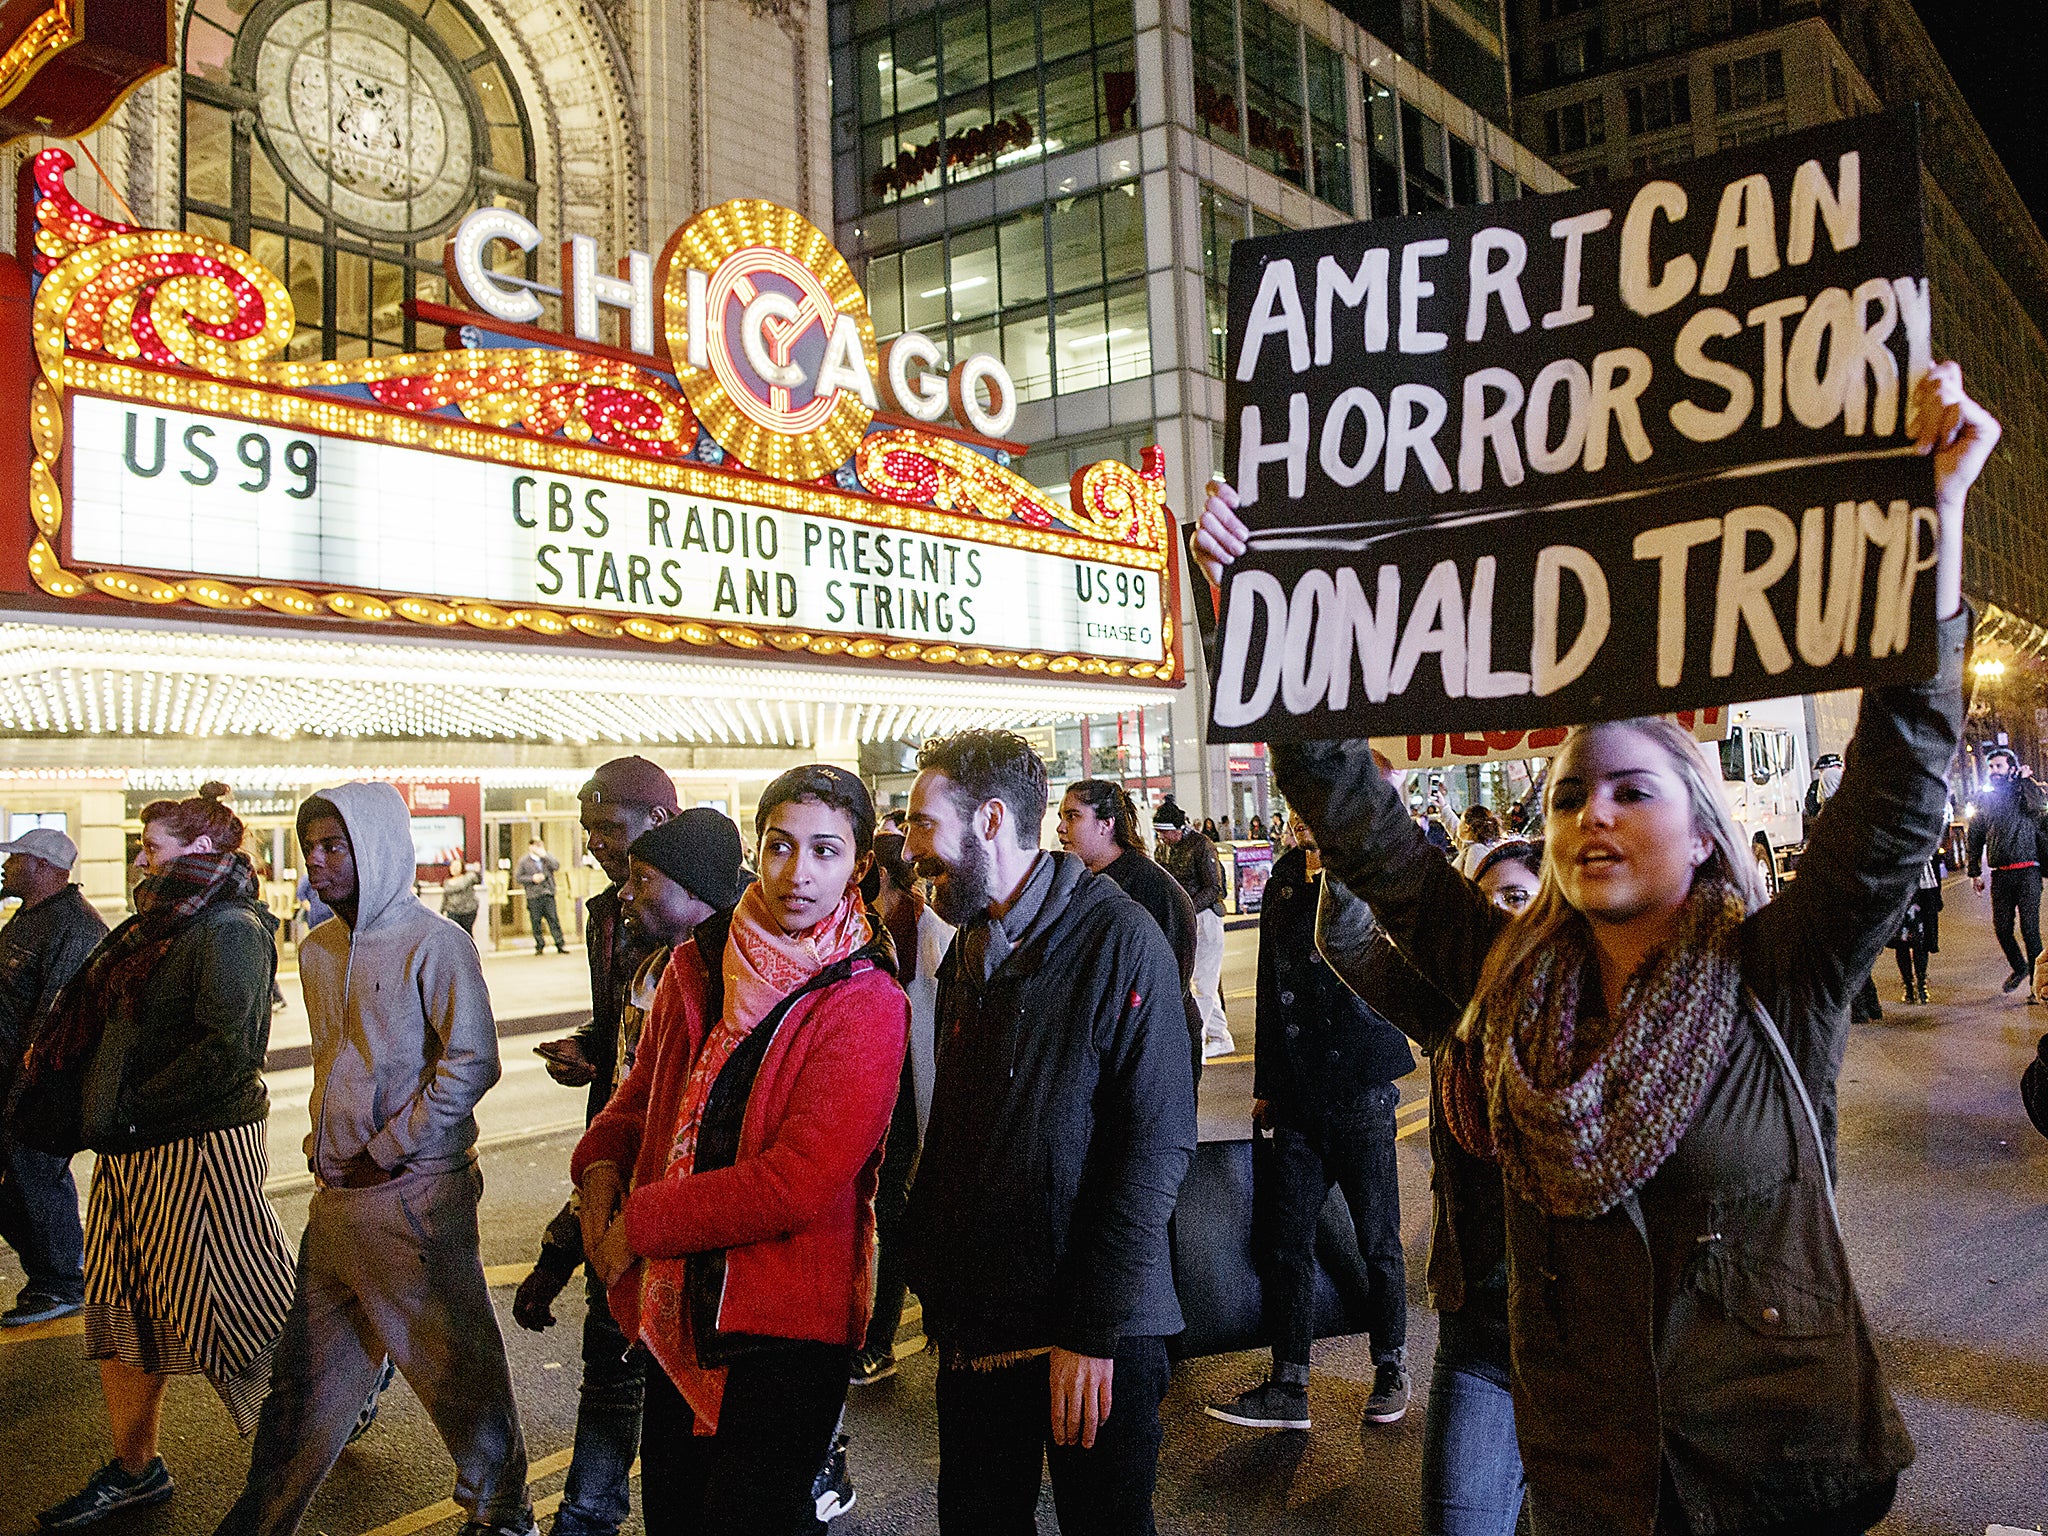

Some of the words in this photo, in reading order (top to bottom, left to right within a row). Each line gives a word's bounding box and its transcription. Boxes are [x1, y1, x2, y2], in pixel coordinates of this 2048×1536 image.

[453, 206, 1018, 439] CHICAGO
[1236, 150, 1860, 382] AMERICAN
[1238, 346, 1654, 508] HORROR
[1668, 276, 1932, 443] STORY
[124, 411, 317, 500] US99
[512, 475, 610, 539] CBS
[648, 496, 778, 561] RADIO
[803, 521, 983, 588] PRESENTS
[1075, 564, 1146, 610] US99
[536, 544, 683, 607] STARS
[712, 565, 797, 619] AND
[825, 579, 977, 636] STRINGS
[1087, 622, 1138, 643] CHASE
[1213, 544, 1611, 727] DONALD
[1633, 499, 1941, 688] TRUMP
